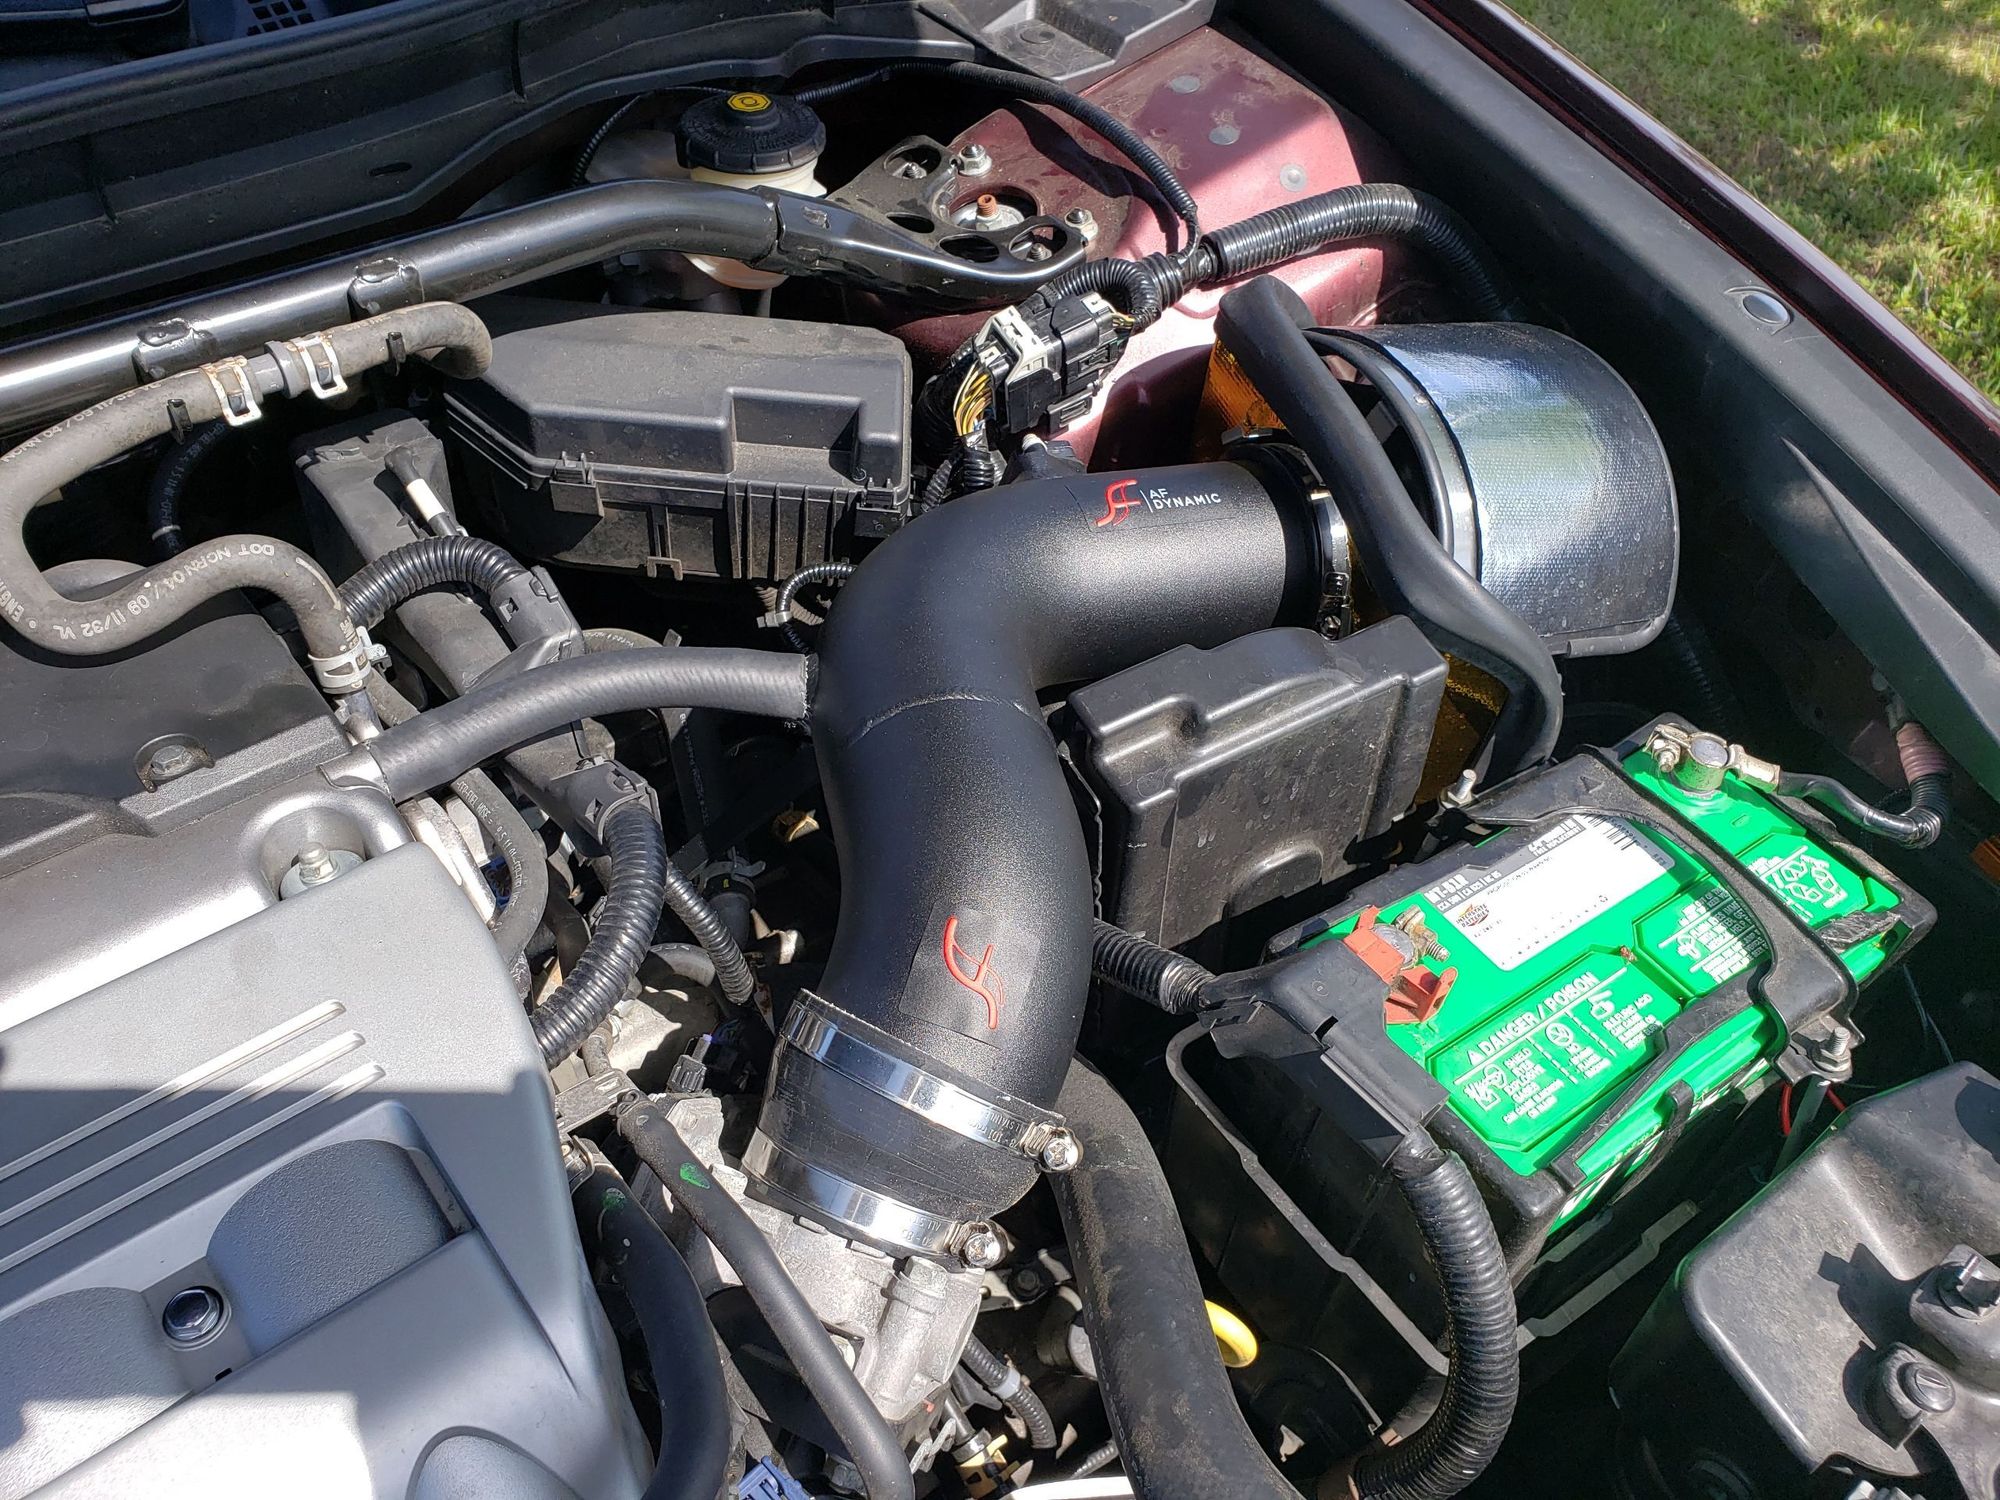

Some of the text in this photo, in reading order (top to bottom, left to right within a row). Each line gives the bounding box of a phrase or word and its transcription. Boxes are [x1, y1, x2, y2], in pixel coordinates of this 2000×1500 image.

[1149, 488, 1168, 499] AF
[1152, 493, 1222, 510] DYNAMIC
[237, 543, 275, 556] DOT
[183, 547, 232, 576] NCRN
[128, 594, 150, 615] 09
[1456, 903, 1487, 924] INTERSTATE
[1461, 909, 1490, 928] BATTERIES
[1731, 920, 1747, 934] HELP
[1478, 1011, 1540, 1057] DANGER
[1545, 971, 1599, 1011] POISON
[1503, 1047, 1533, 1069] SHIELD
